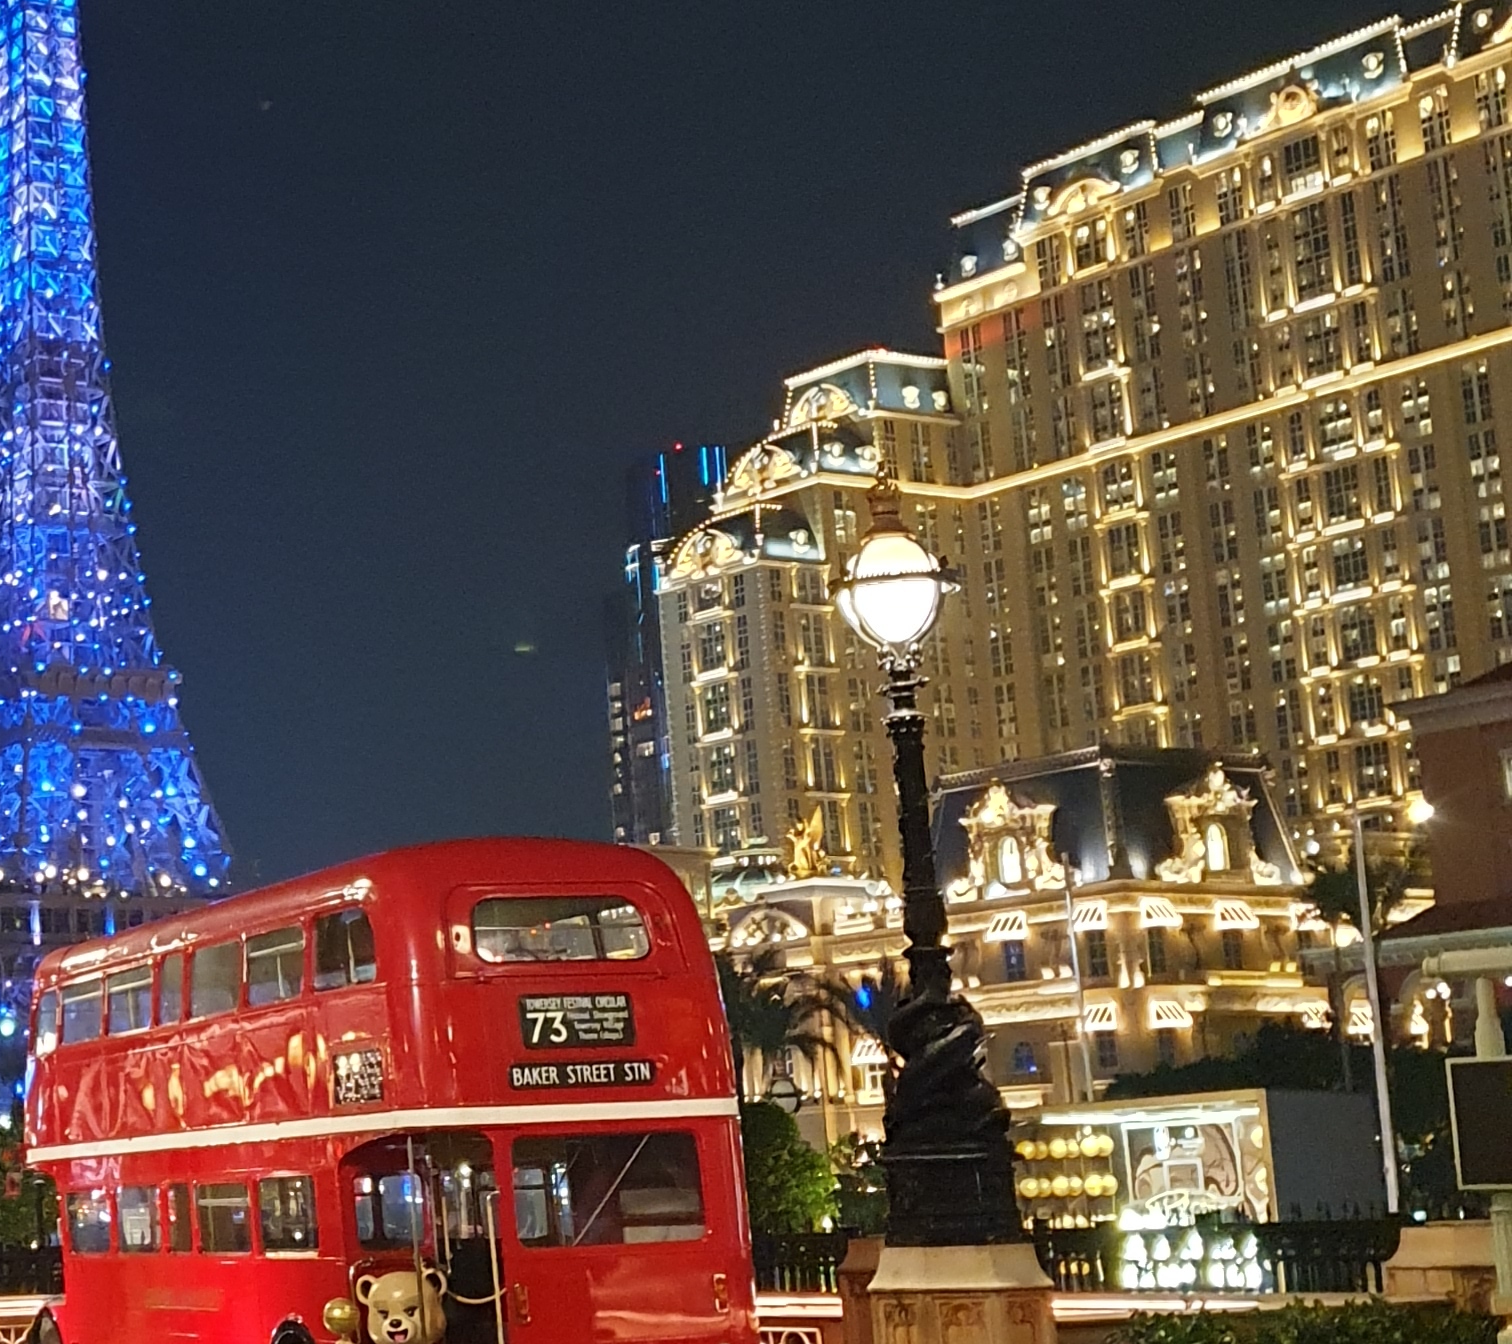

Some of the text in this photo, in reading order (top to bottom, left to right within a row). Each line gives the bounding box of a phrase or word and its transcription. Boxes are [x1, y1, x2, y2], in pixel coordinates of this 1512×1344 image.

[526, 1011, 568, 1043] 73
[512, 1062, 651, 1087] BAKER STREET STN
